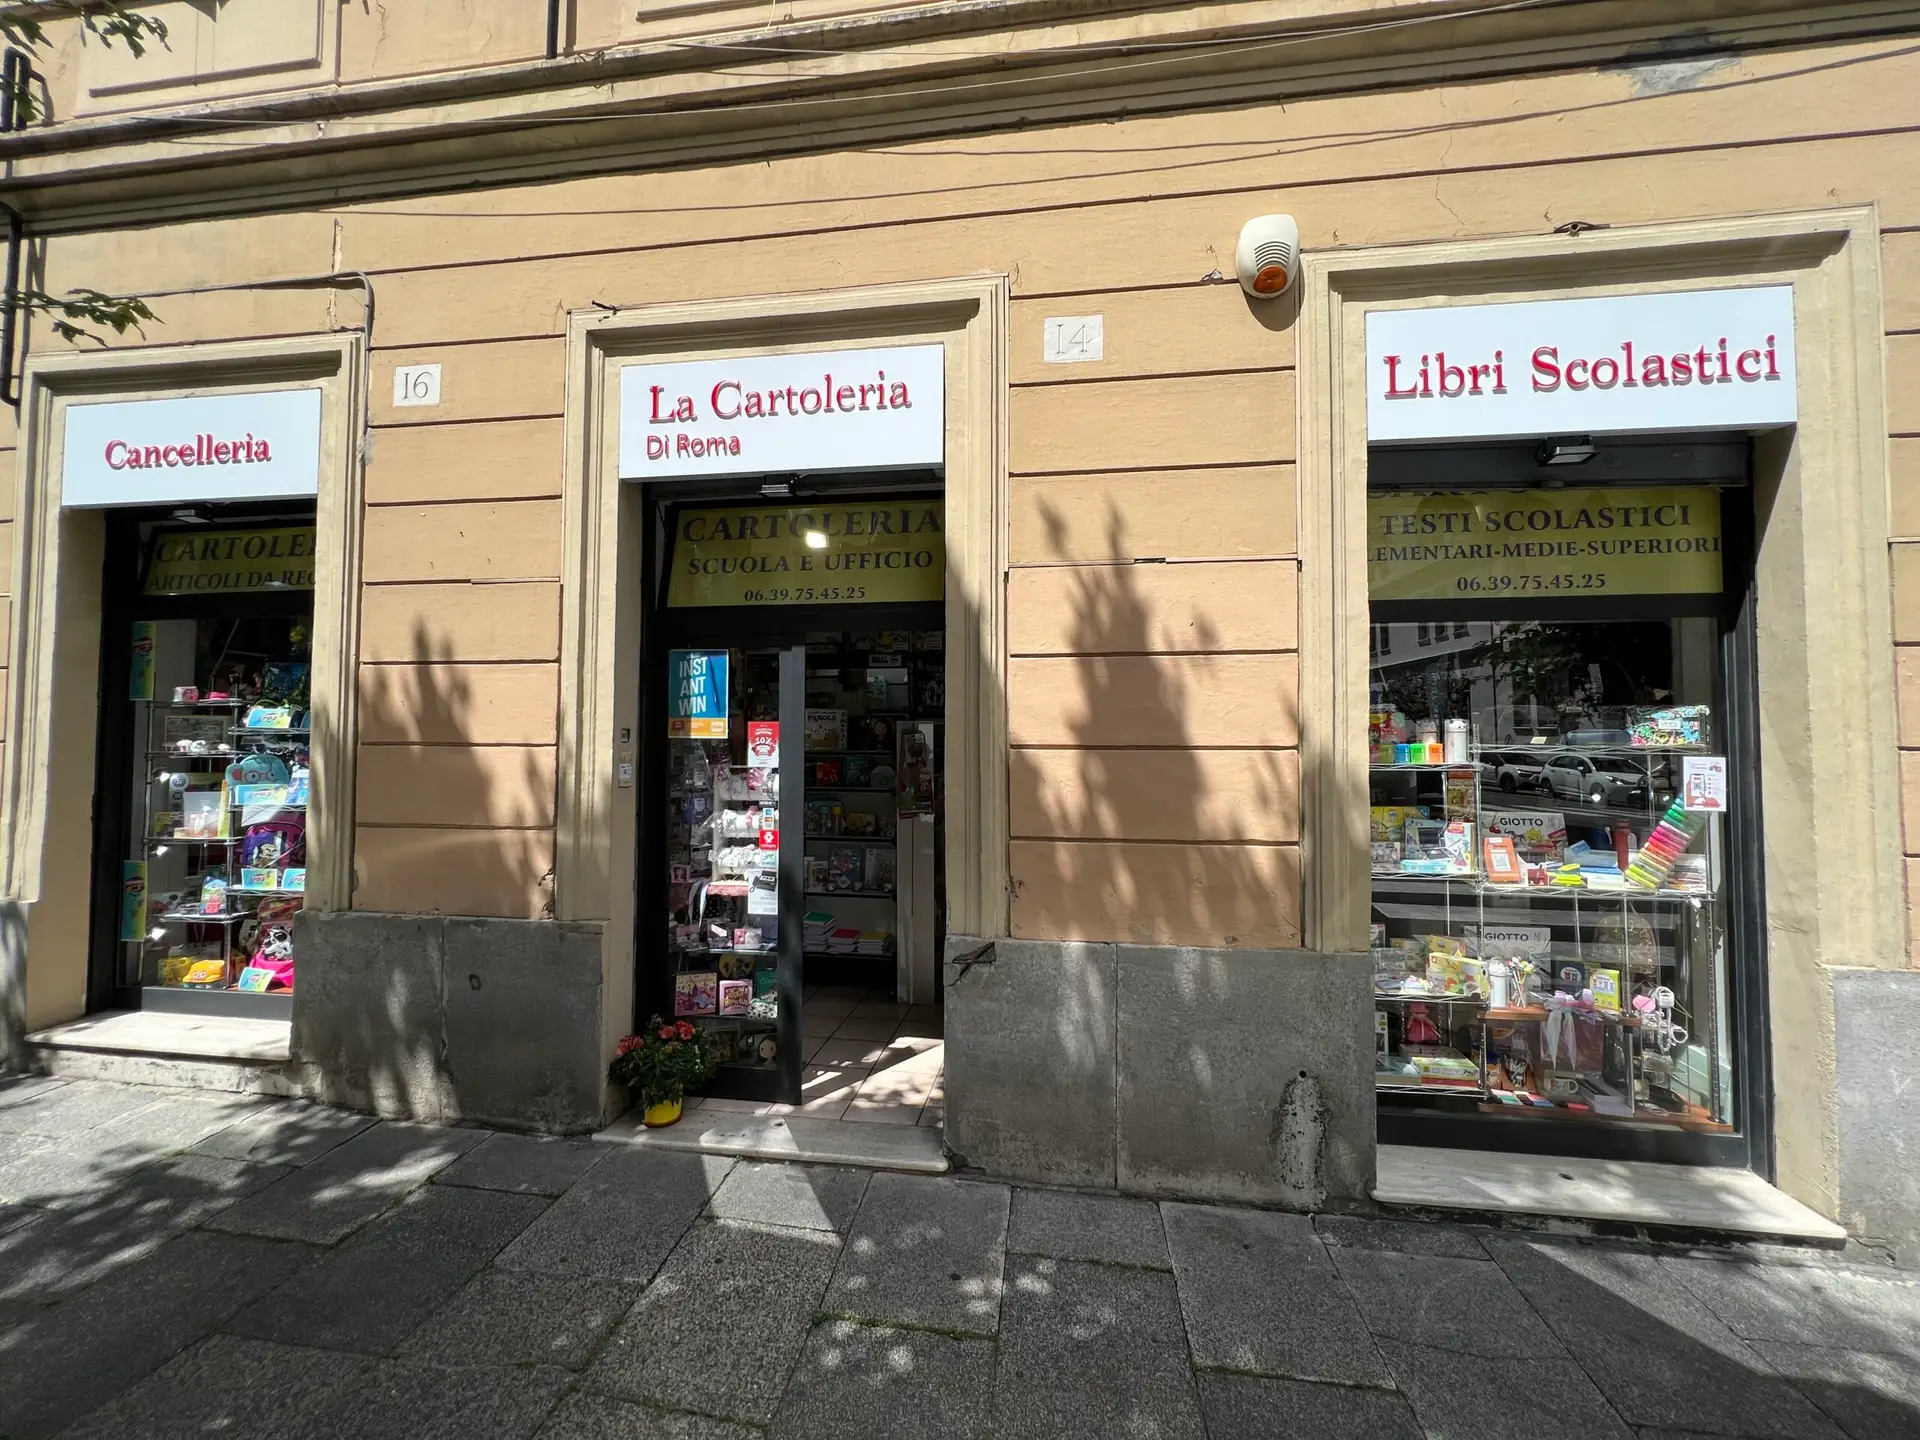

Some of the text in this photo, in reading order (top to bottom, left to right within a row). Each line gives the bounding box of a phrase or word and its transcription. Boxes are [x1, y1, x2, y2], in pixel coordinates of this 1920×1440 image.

[1056, 323, 1092, 354] 14
[1383, 334, 1781, 400] Libri Scolastici
[402, 371, 433, 400] 16
[648, 370, 912, 423] La Cartoleria
[104, 432, 272, 470] Cancelleria
[676, 433, 741, 458] Roma
[682, 508, 942, 543] CARTOLERIA
[1380, 504, 1692, 536] TESTI SCOLASTICI
[688, 550, 934, 575] SCUOLA E UFFICIO
[149, 572, 243, 592] ARTICOLI
[743, 585, 866, 603] 06.39.75.45.25
[1456, 573, 1607, 593] 06.39.75.45.25
[679, 656, 708, 678] INST
[680, 676, 707, 697] ANT
[678, 695, 707, 716] WIN
[1500, 816, 1544, 827] GIOTTO
[1485, 932, 1529, 942] GIOTTO
